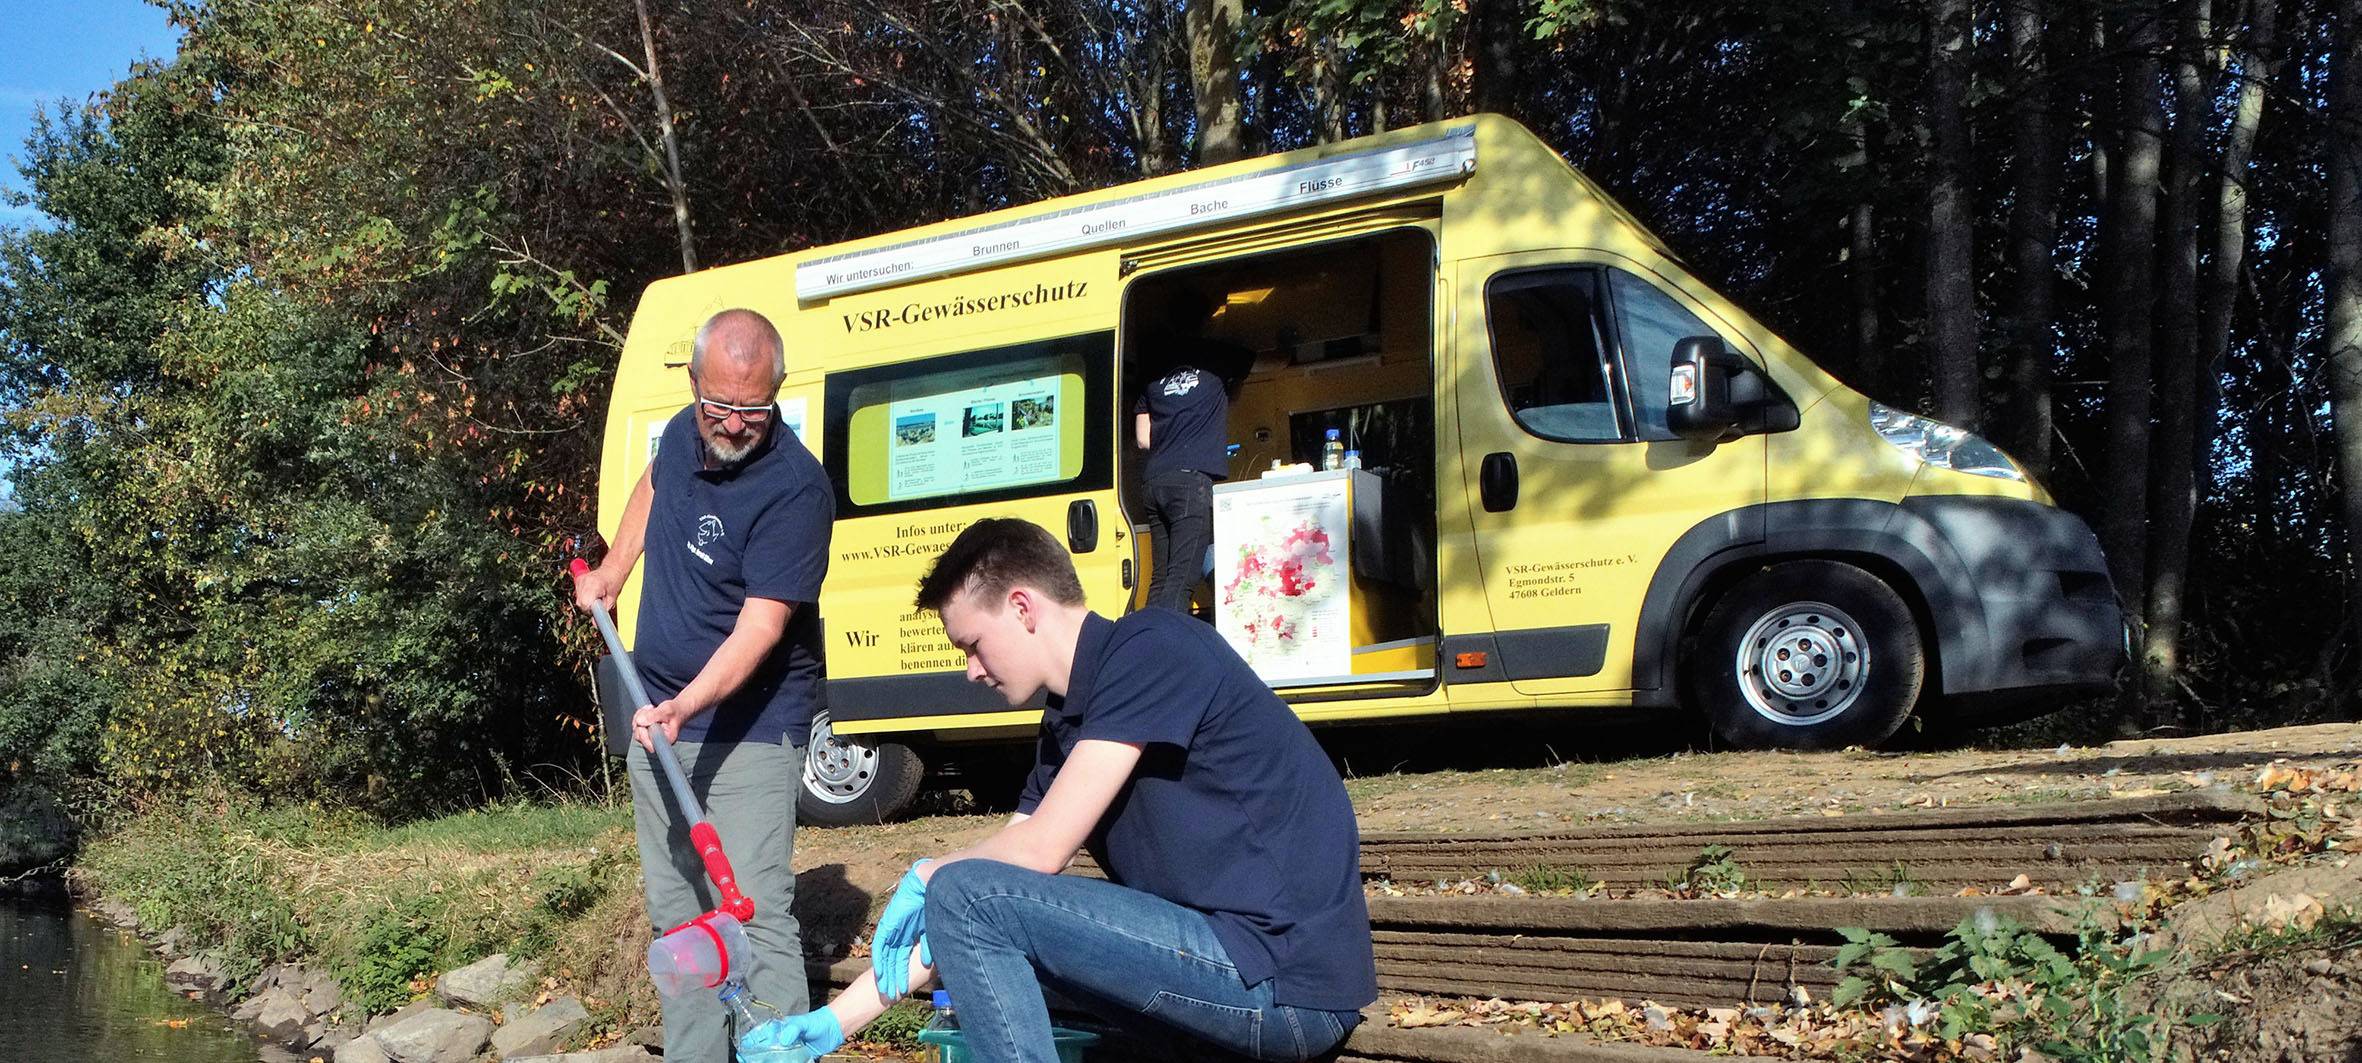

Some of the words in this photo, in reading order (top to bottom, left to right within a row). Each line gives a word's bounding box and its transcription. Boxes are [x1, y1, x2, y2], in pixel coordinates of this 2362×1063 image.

[826, 273, 844, 285] Wir
[846, 261, 914, 282] untersuchen:
[972, 239, 1020, 256] Brunnen
[1081, 219, 1127, 235] Quellen
[843, 280, 1088, 334] VSR-Gewässerschutz
[896, 525, 926, 538] Infos
[930, 522, 967, 534] unter:
[1505, 557, 1613, 575] VSR-Gewässerschutz
[1627, 554, 1638, 564] V.
[1509, 575, 1566, 588] Egmondstr.
[1568, 572, 1575, 582] 5
[1509, 589, 1538, 599] 47608
[1540, 586, 1582, 597] Geldern
[845, 630, 880, 648] Wir
[900, 643, 934, 654] klären
[900, 659, 952, 671] benennen
[955, 655, 968, 667] di
